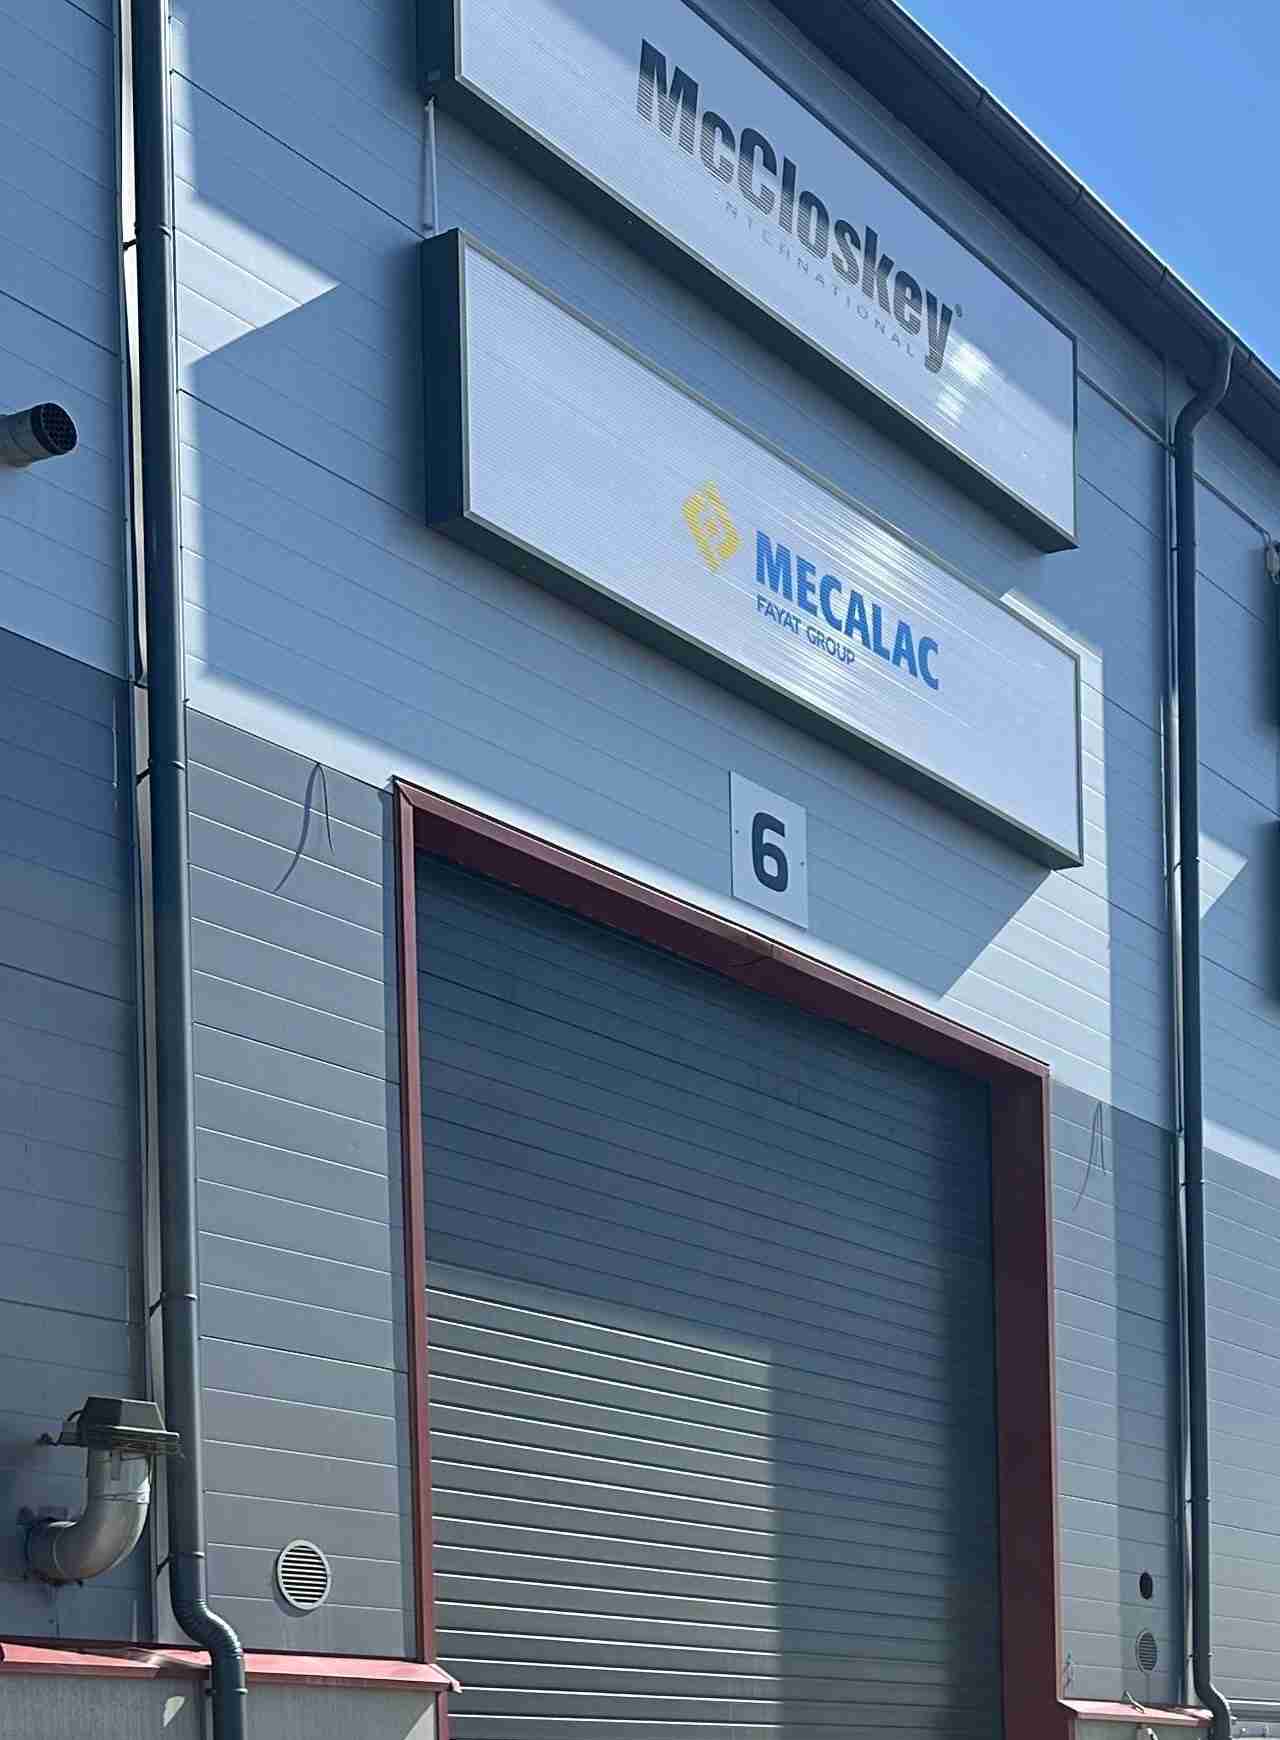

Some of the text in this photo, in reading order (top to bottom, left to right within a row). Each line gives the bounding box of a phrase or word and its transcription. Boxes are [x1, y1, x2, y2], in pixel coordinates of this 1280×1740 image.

[636, 38, 955, 374] McCloskey
[755, 530, 939, 690] MECALAC
[757, 594, 856, 665] FAYAT GROUP
[751, 812, 789, 893] 6
